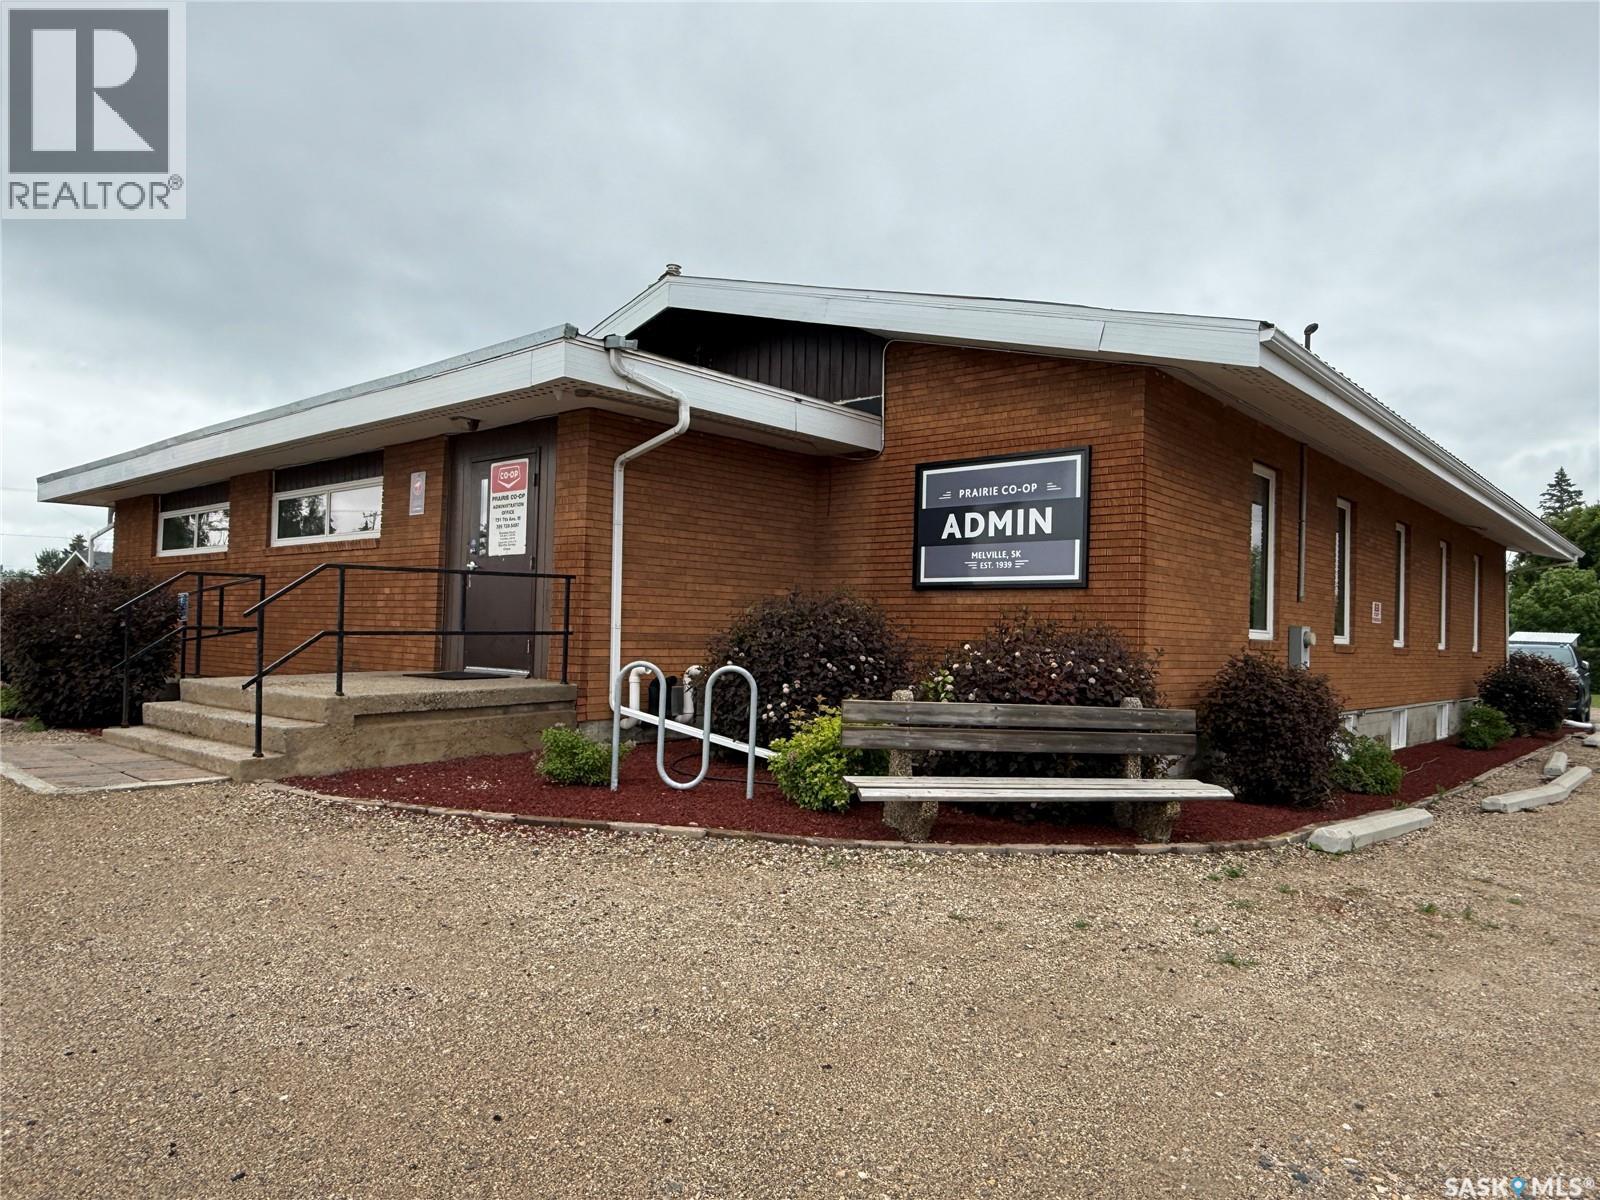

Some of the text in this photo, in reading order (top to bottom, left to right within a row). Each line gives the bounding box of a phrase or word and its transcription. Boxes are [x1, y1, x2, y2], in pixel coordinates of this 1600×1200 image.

[500, 470, 519, 480] CO-OP
[959, 483, 1038, 498] PRAIRIE CO-OP
[941, 507, 1052, 540] ADMIN
[971, 550, 1022, 560] MELVILLE, SK
[980, 560, 1012, 569] EST. 1939
